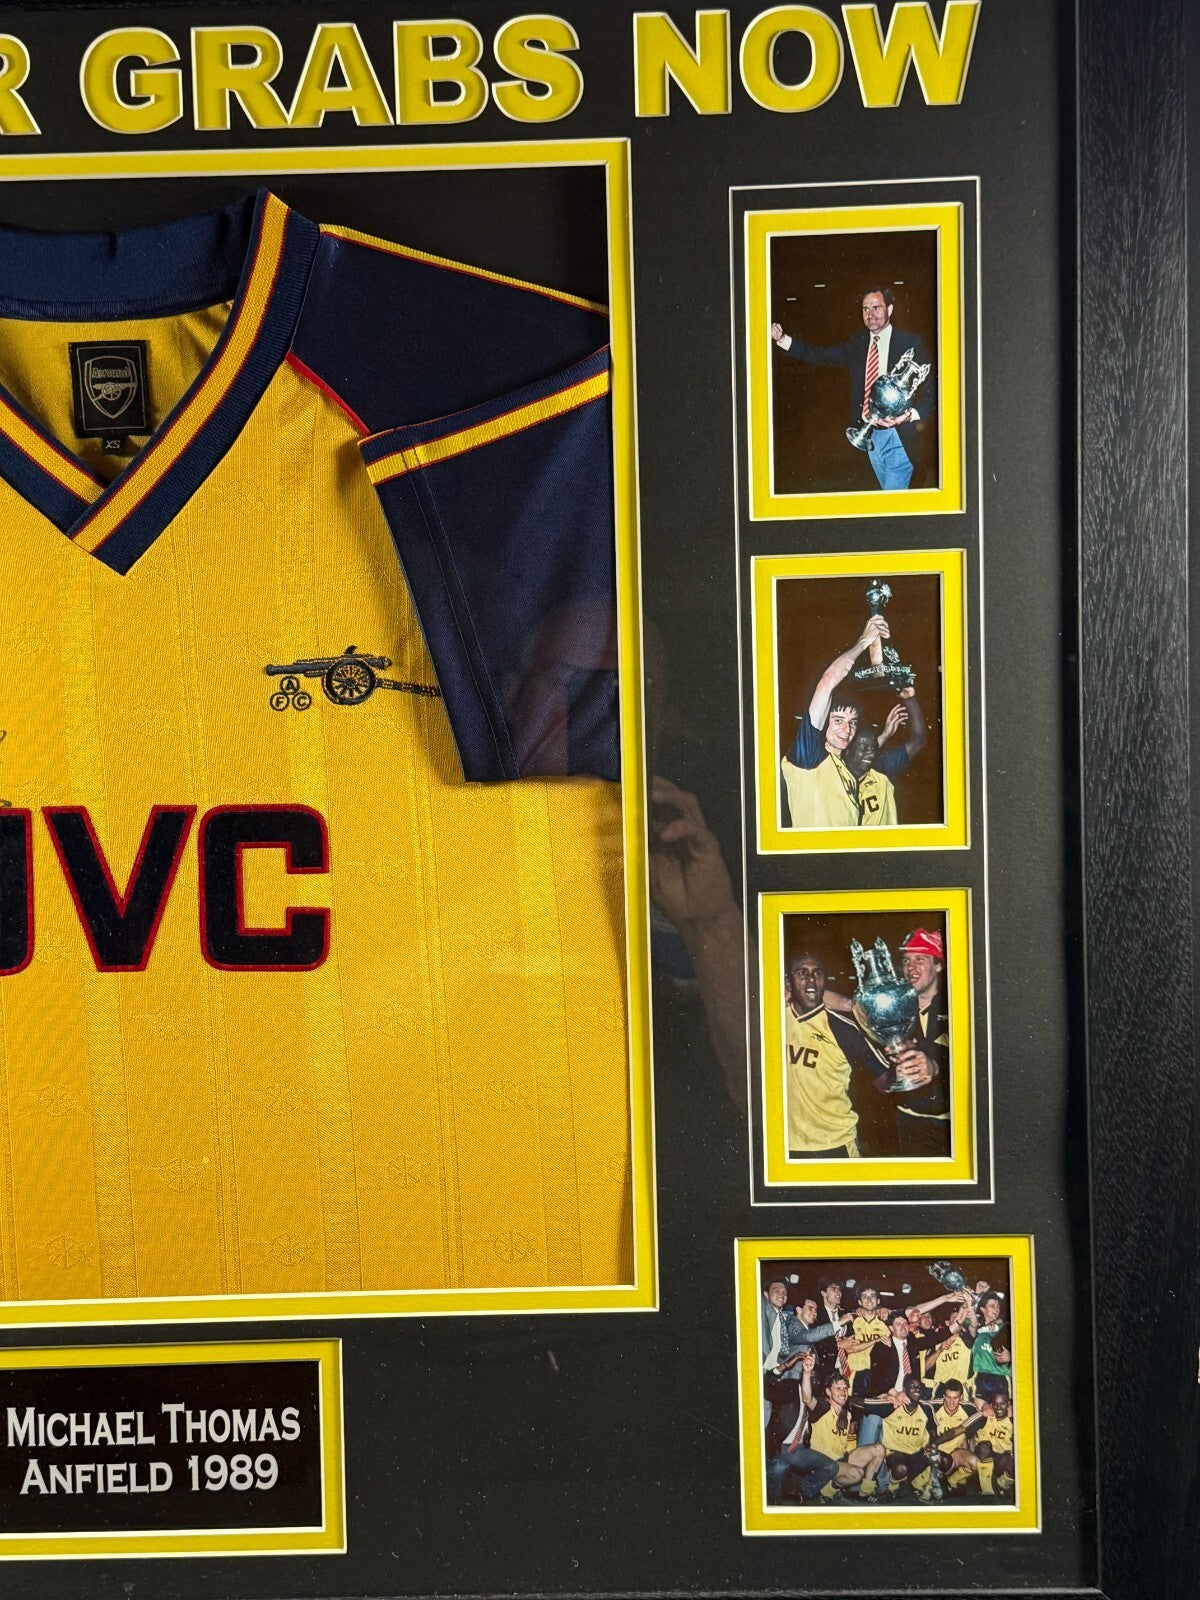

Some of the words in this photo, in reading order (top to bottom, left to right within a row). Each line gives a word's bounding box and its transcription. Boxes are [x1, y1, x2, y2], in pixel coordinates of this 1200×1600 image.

[79, 14, 585, 136] GRABS
[633, 0, 983, 118] NOW
[105, 440, 121, 450] XS
[786, 1044, 819, 1069] VC
[941, 1351, 960, 1363] JVC
[6, 1406, 156, 1448] MICHAEL
[161, 1402, 302, 1444] THOMAS
[896, 1426, 920, 1436] JVC
[19, 1458, 174, 1495] ANFIELD
[187, 1453, 279, 1491] 1989
